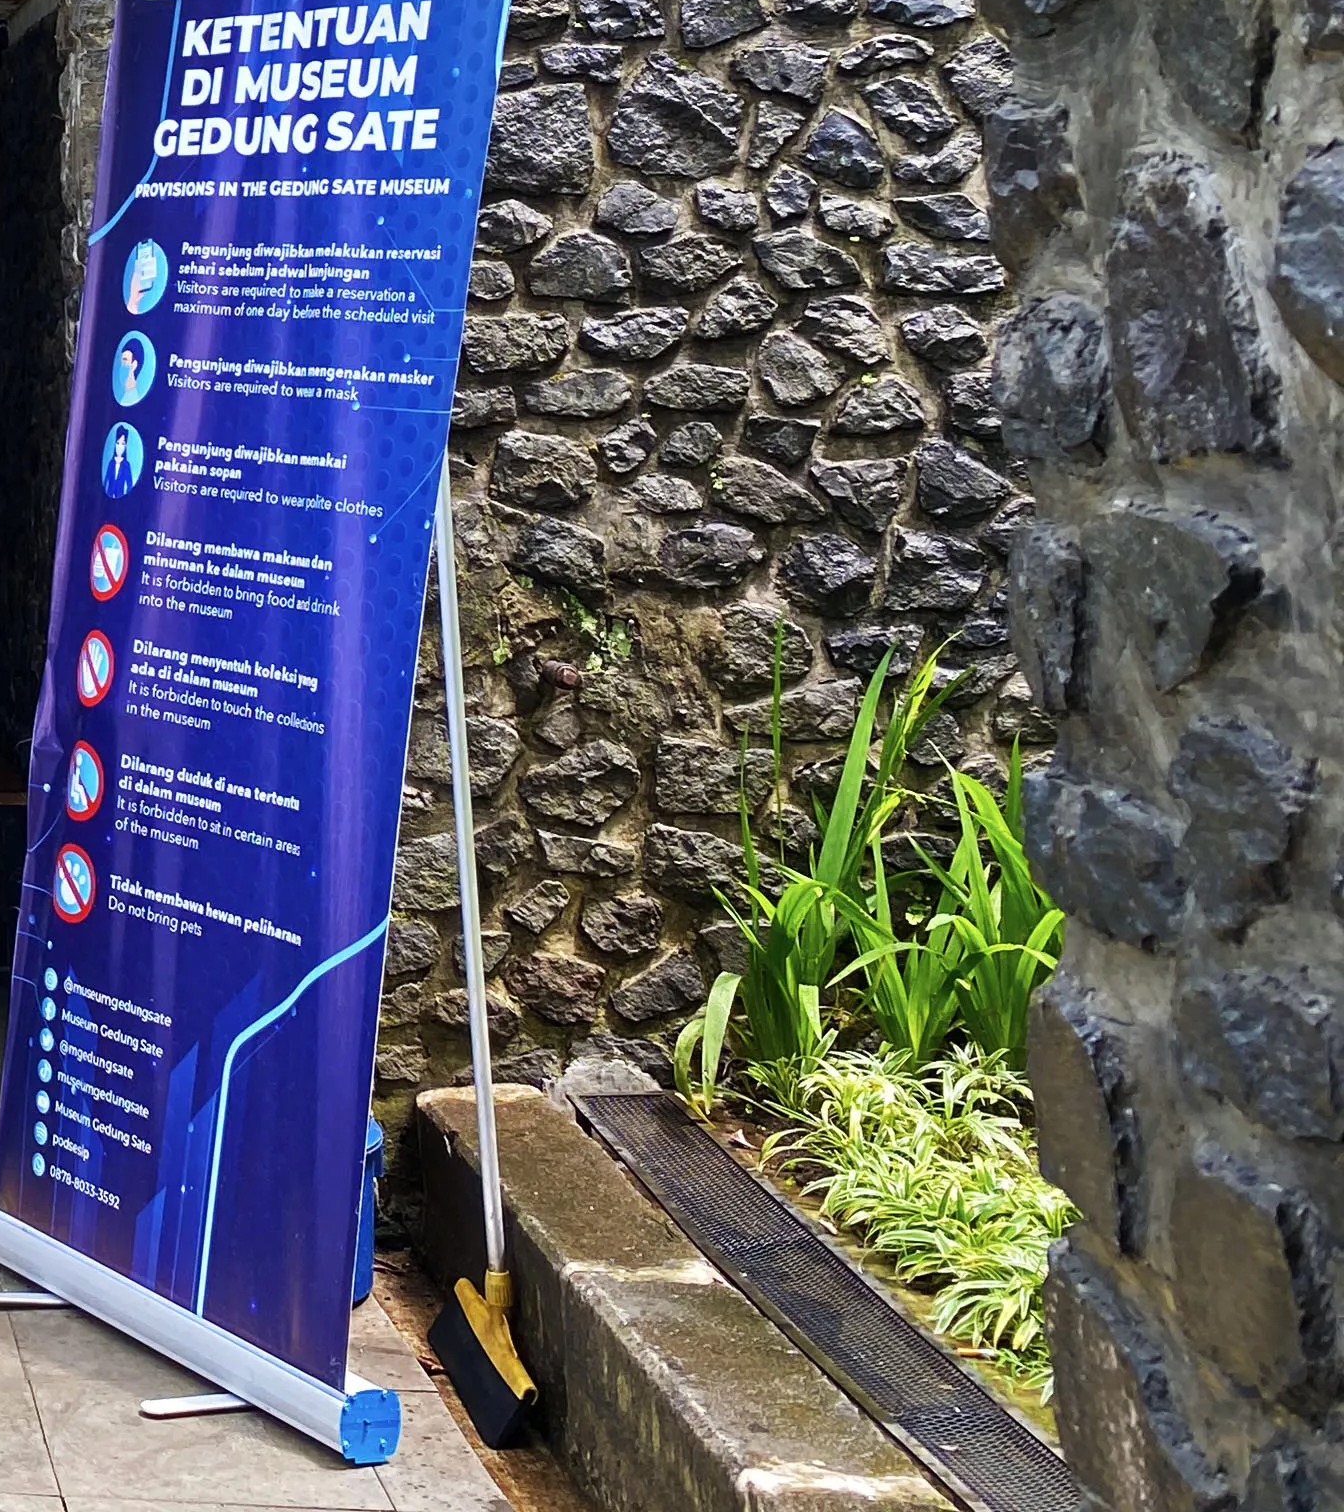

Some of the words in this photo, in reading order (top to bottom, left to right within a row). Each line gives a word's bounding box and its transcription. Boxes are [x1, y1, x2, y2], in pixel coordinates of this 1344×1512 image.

[182, 0, 431, 57] KETENTUAN
[180, 66, 223, 106] DI
[234, 55, 418, 103] MUSEUM
[153, 113, 318, 157] GEDUNG
[324, 108, 440, 151] SATE
[134, 180, 215, 198] PROVISIONS
[218, 181, 238, 196] IN
[241, 180, 267, 197] THE
[269, 178, 329, 196] GEDUNG
[331, 178, 377, 195] SATE
[379, 178, 450, 195] MUSEUM
[181, 241, 252, 261] Pengunjung
[253, 242, 314, 261] diwajibkan
[315, 242, 383, 259] melakukan
[385, 244, 441, 260] reservasi
[173, 300, 231, 316] maximum
[233, 302, 244, 316] of
[245, 306, 264, 316] one
[266, 301, 291, 322] day
[322, 303, 341, 319] the
[344, 305, 409, 323] scheduled
[411, 309, 435, 324] visit
[143, 551, 204, 573] minuman
[206, 559, 220, 575] ke
[221, 562, 254, 581] dalam
[256, 572, 305, 589] museum
[139, 594, 163, 607] into
[166, 595, 185, 611] the
[188, 603, 232, 619] museum
[130, 661, 155, 677] ada
[157, 665, 171, 680] di
[173, 668, 210, 688] dalam
[212, 679, 258, 698] museum
[126, 703, 137, 715] in
[140, 702, 160, 719] the
[162, 711, 210, 730] museum
[128, 679, 137, 694] It
[139, 685, 149, 696] is
[151, 683, 209, 708] forbidden
[210, 697, 221, 711] to
[222, 700, 252, 718] touch
[254, 705, 274, 723] the
[118, 775, 132, 790] di
[134, 778, 172, 800] dalam
[175, 791, 221, 813] museum
[120, 753, 174, 783] Dilarang
[176, 767, 213, 789] duduk
[214, 776, 226, 792] di
[226, 783, 251, 799] area
[114, 816, 129, 831] of
[130, 819, 148, 836] the
[150, 828, 198, 849] museum
[108, 895, 125, 913] Do
[128, 905, 145, 919] not
[146, 906, 178, 932] bring
[180, 920, 202, 936] pets
[110, 874, 142, 897] Tidak
[205, 901, 242, 927] hewan
[63, 975, 172, 1027] @museumgedungsate
[61, 1008, 98, 1034] Museum
[99, 1024, 139, 1052] Gedung
[139, 1038, 163, 1058] Sate
[59, 1039, 133, 1079] @mgedungsate
[57, 1071, 149, 1119] museumgedungsate
[54, 1100, 90, 1128] Museum
[92, 1117, 130, 1147] Gedung
[130, 1134, 151, 1154] Sate
[49, 1164, 120, 1210] 0878-8033-3592
